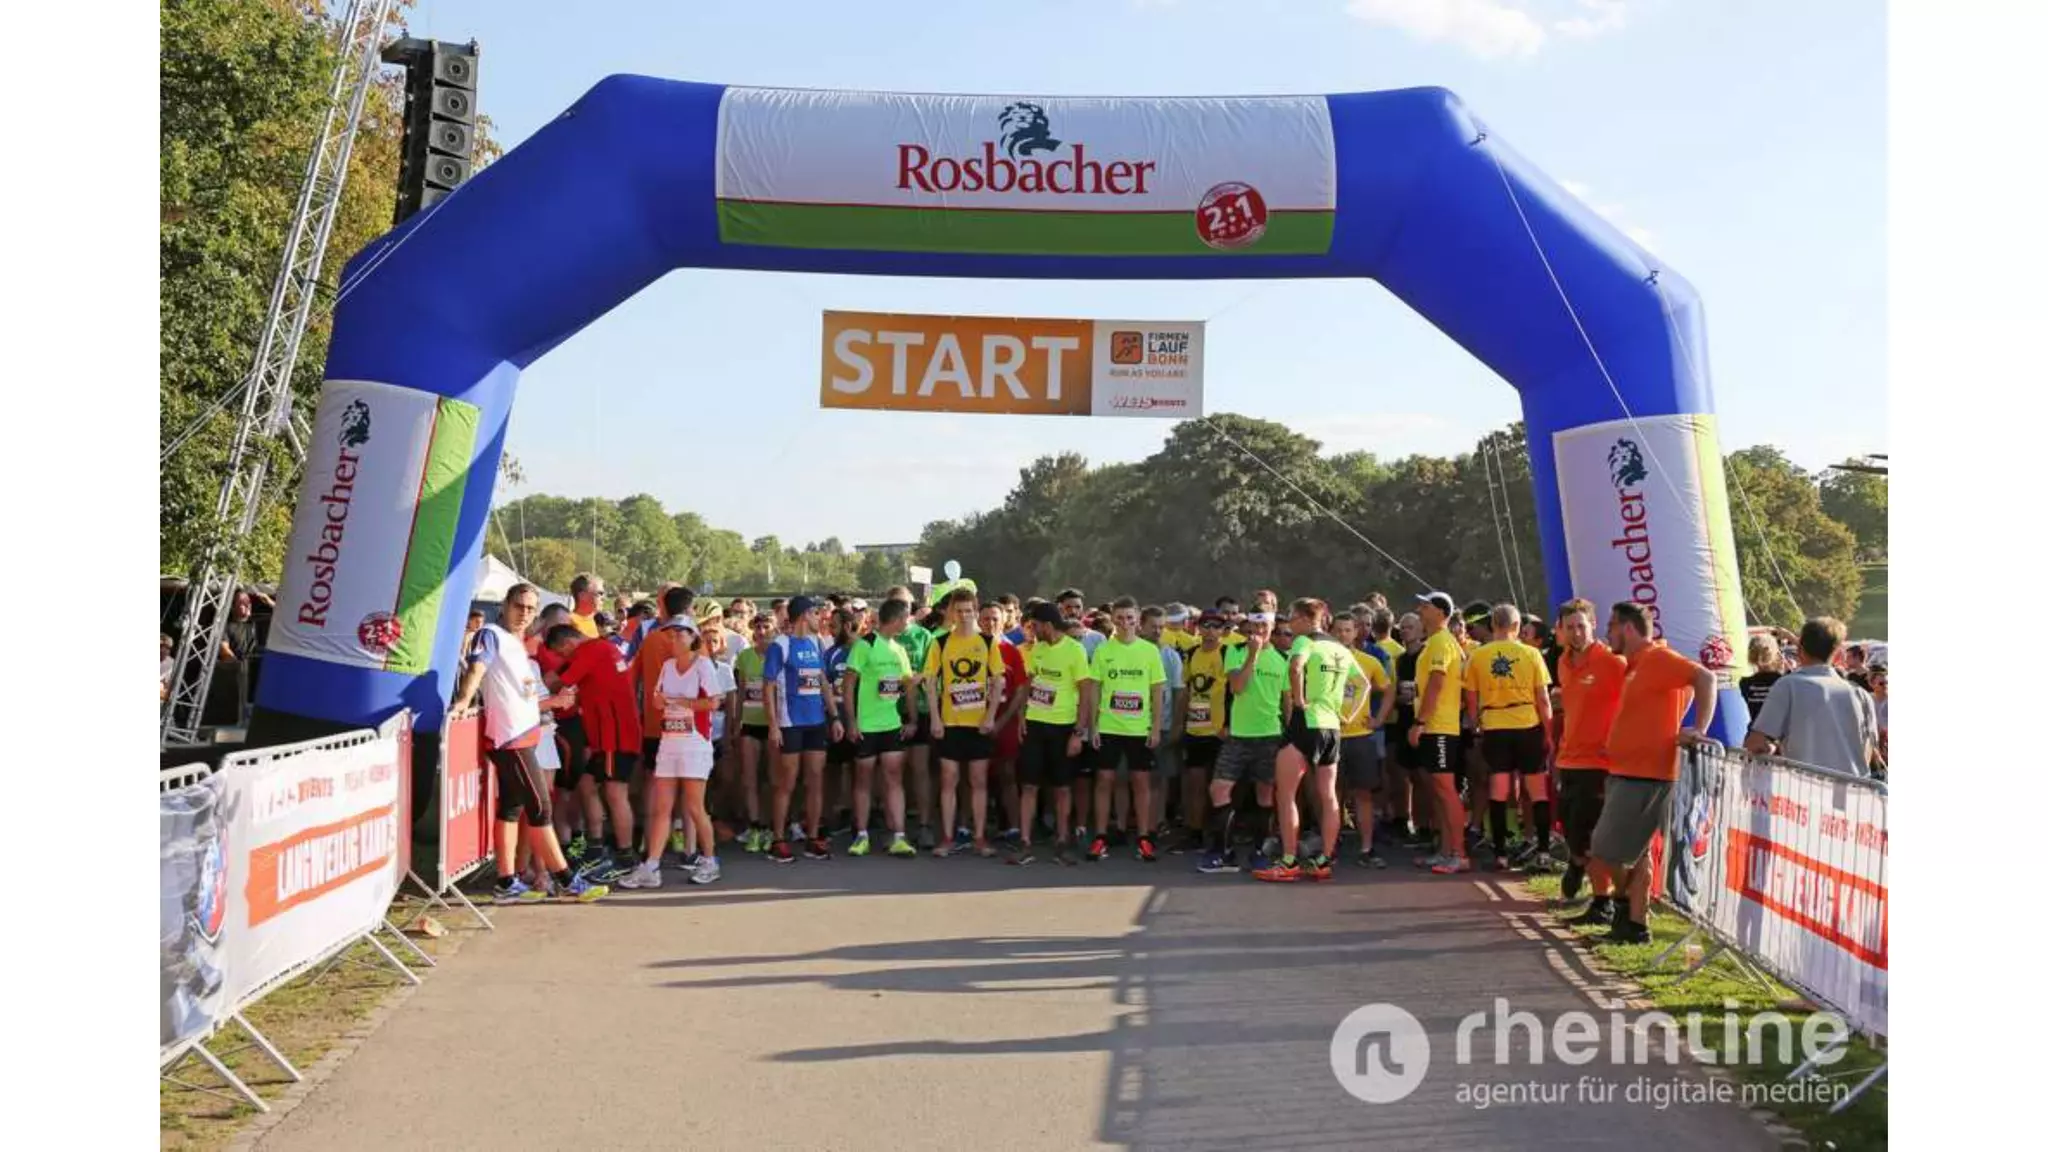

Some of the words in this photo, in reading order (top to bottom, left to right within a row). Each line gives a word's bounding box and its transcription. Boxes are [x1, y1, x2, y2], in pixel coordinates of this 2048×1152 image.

[895, 142, 1156, 195] Rosbacher
[1204, 194, 1252, 231] 2:1
[1147, 332, 1189, 341] FIRMEN
[1147, 341, 1189, 353] LAUF
[831, 329, 1079, 401] START
[1147, 354, 1189, 365] BONN
[298, 447, 360, 628] Rosbacher
